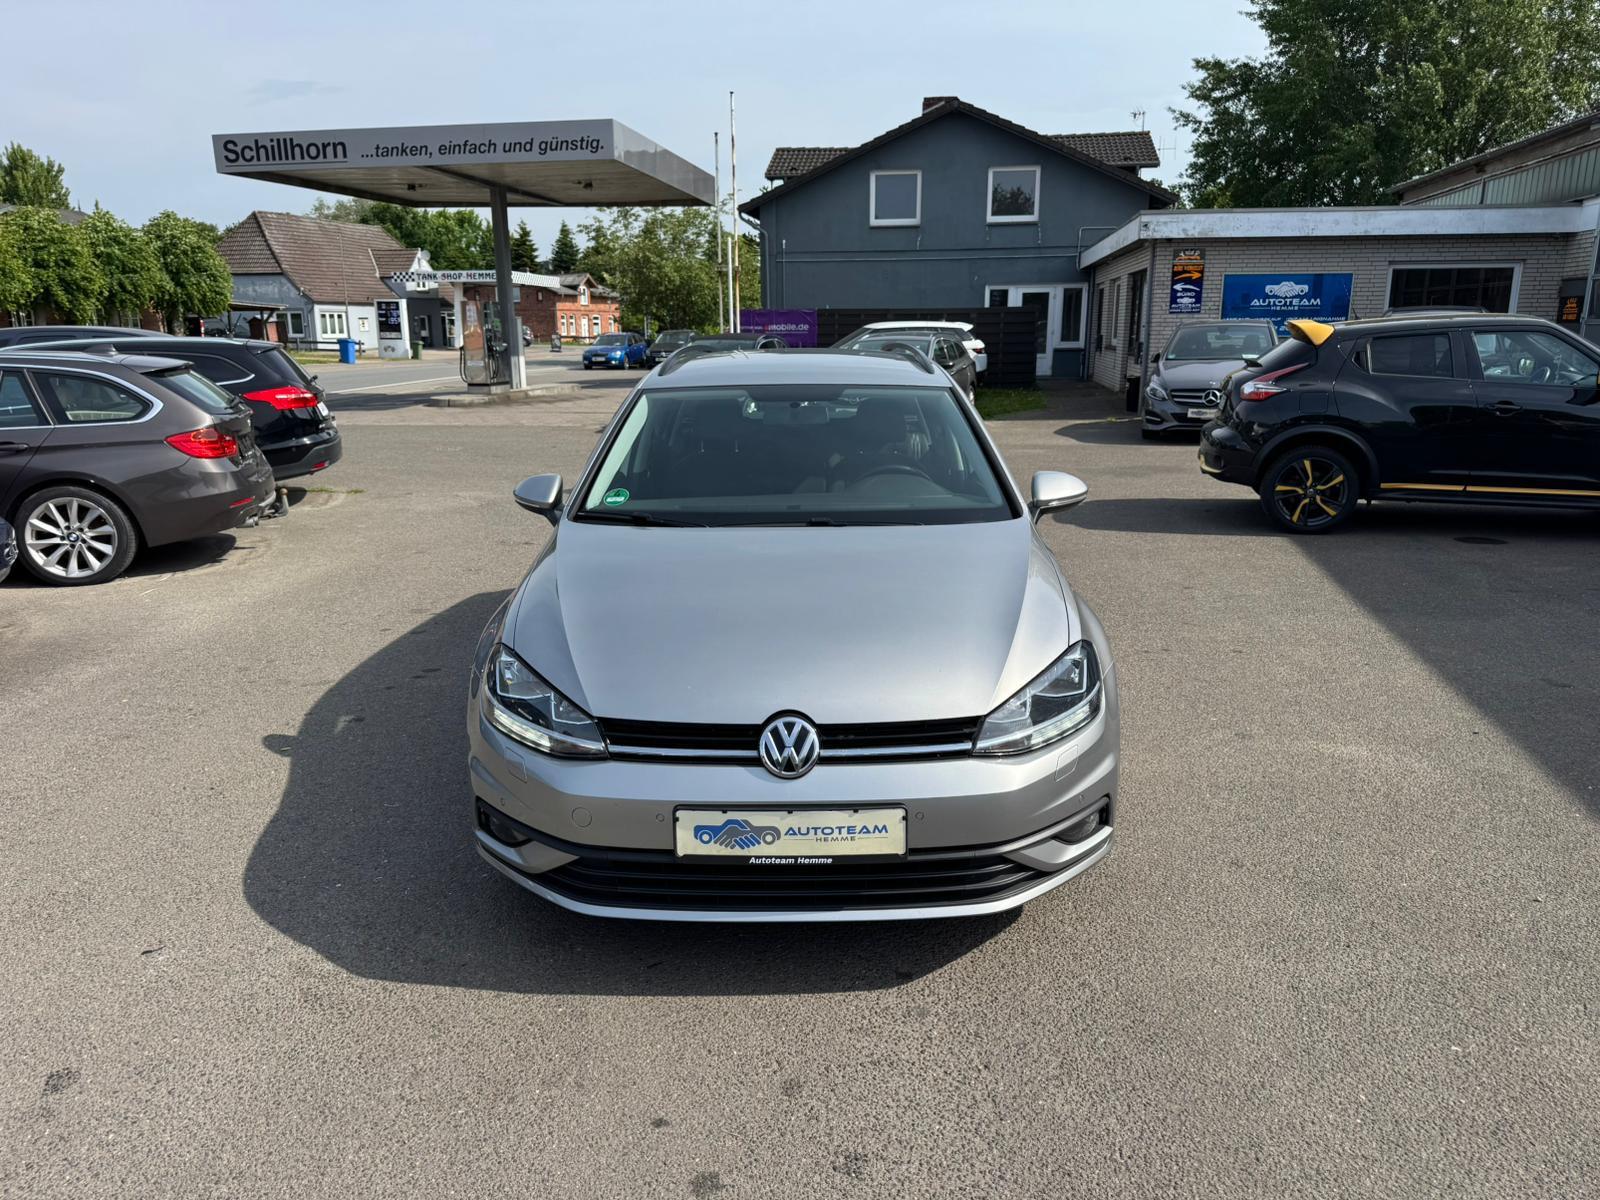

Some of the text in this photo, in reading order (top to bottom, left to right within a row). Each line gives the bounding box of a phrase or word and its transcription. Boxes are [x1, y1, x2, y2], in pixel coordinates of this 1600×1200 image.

[223, 137, 347, 163] Schillhorn
[361, 135, 604, 159] ...tanken, einfach und günstig.
[1250, 298, 1321, 306] AUTOTEAM
[768, 323, 809, 331] mobile.de
[784, 824, 889, 836] AUTOTEAM
[749, 856, 833, 865] Autoteam Hemme
